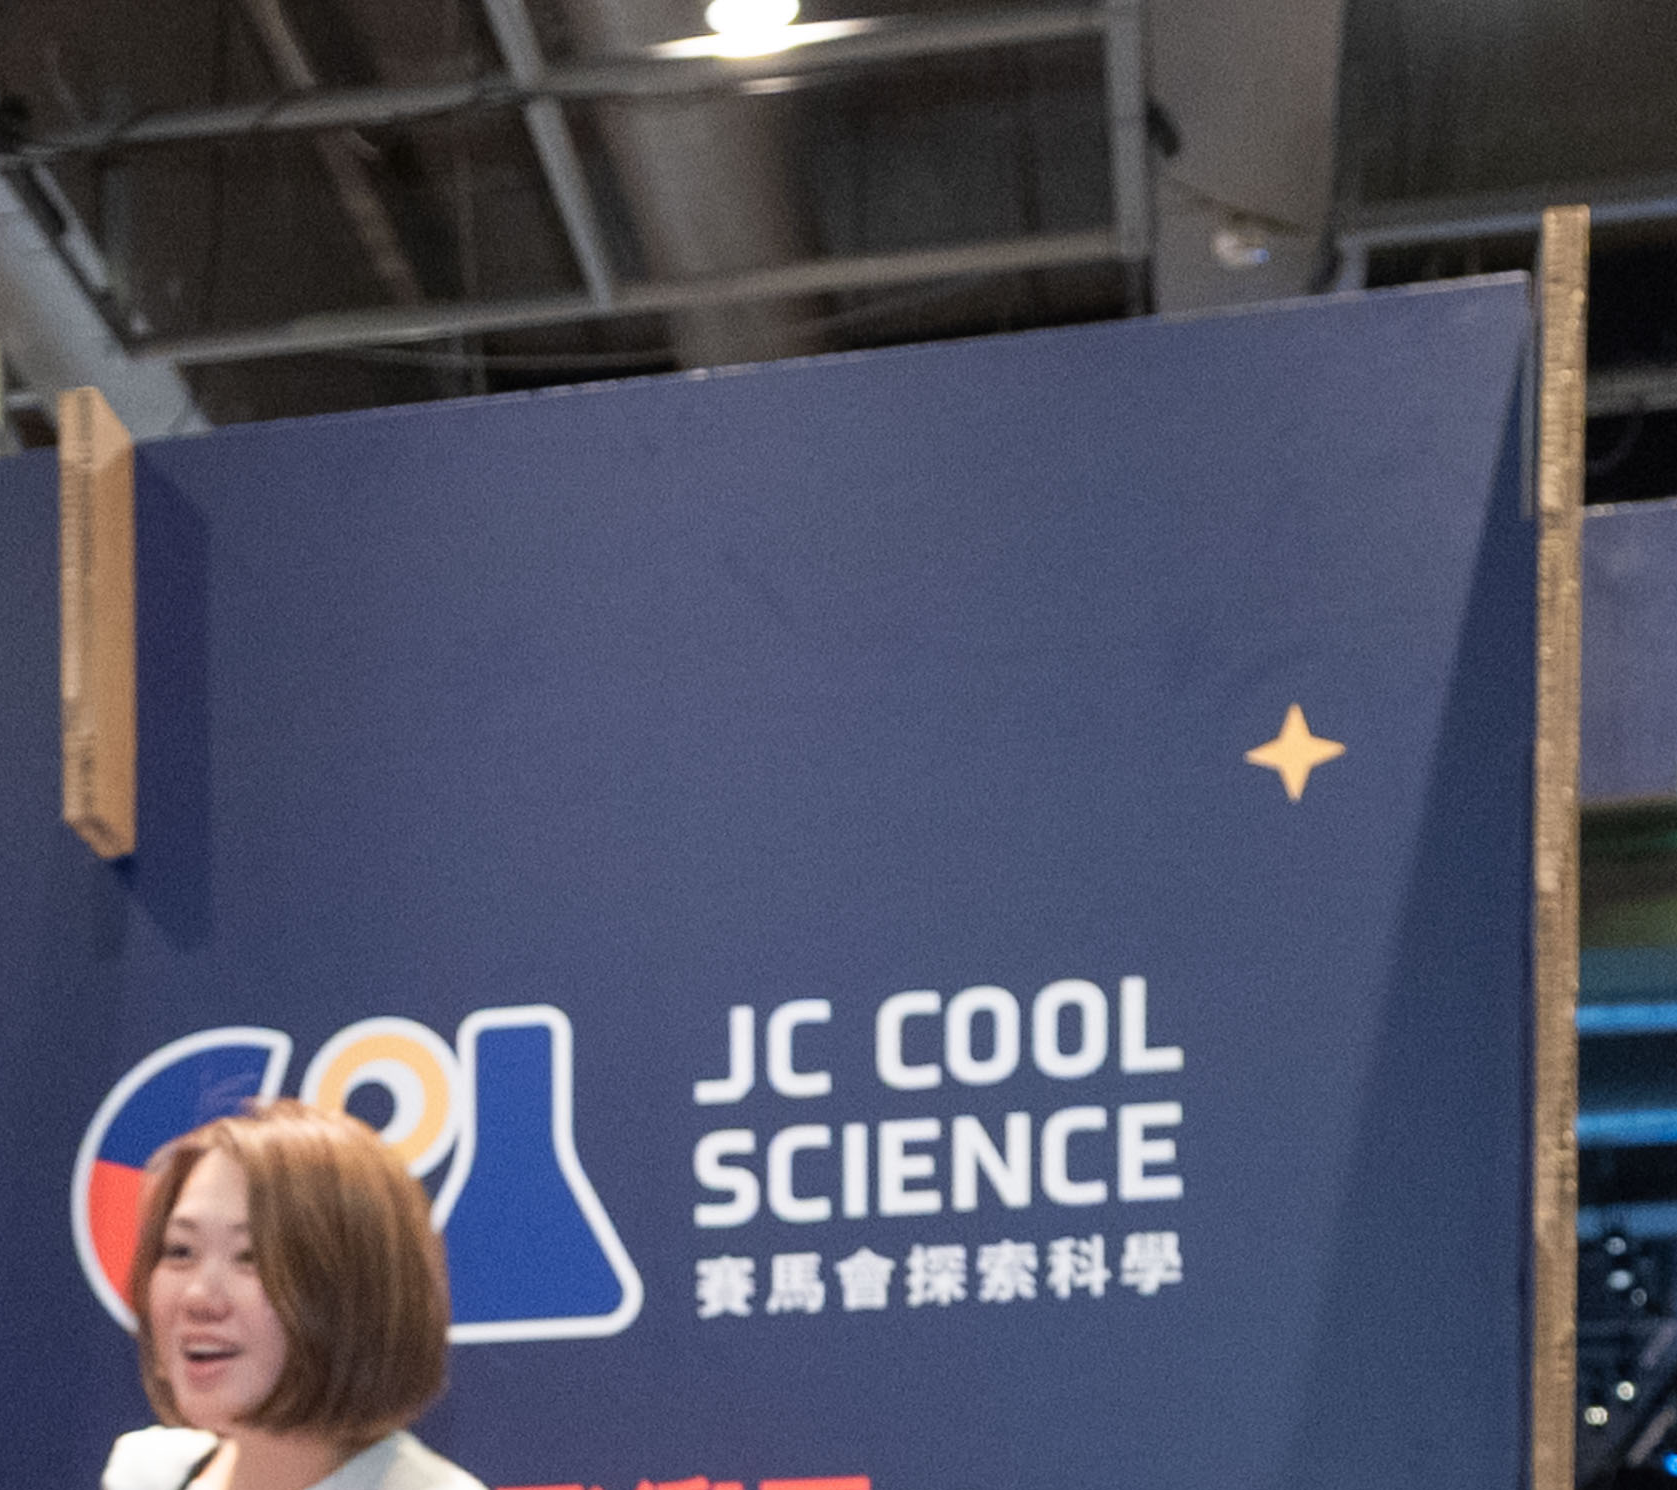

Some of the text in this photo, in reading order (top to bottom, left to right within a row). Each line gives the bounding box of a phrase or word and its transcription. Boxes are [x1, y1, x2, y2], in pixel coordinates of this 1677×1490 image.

[694, 975, 1184, 1105] JC COOL
[693, 1101, 1184, 1228] SCIENCE
[695, 1231, 1184, 1319] 賽馬會探索科學
